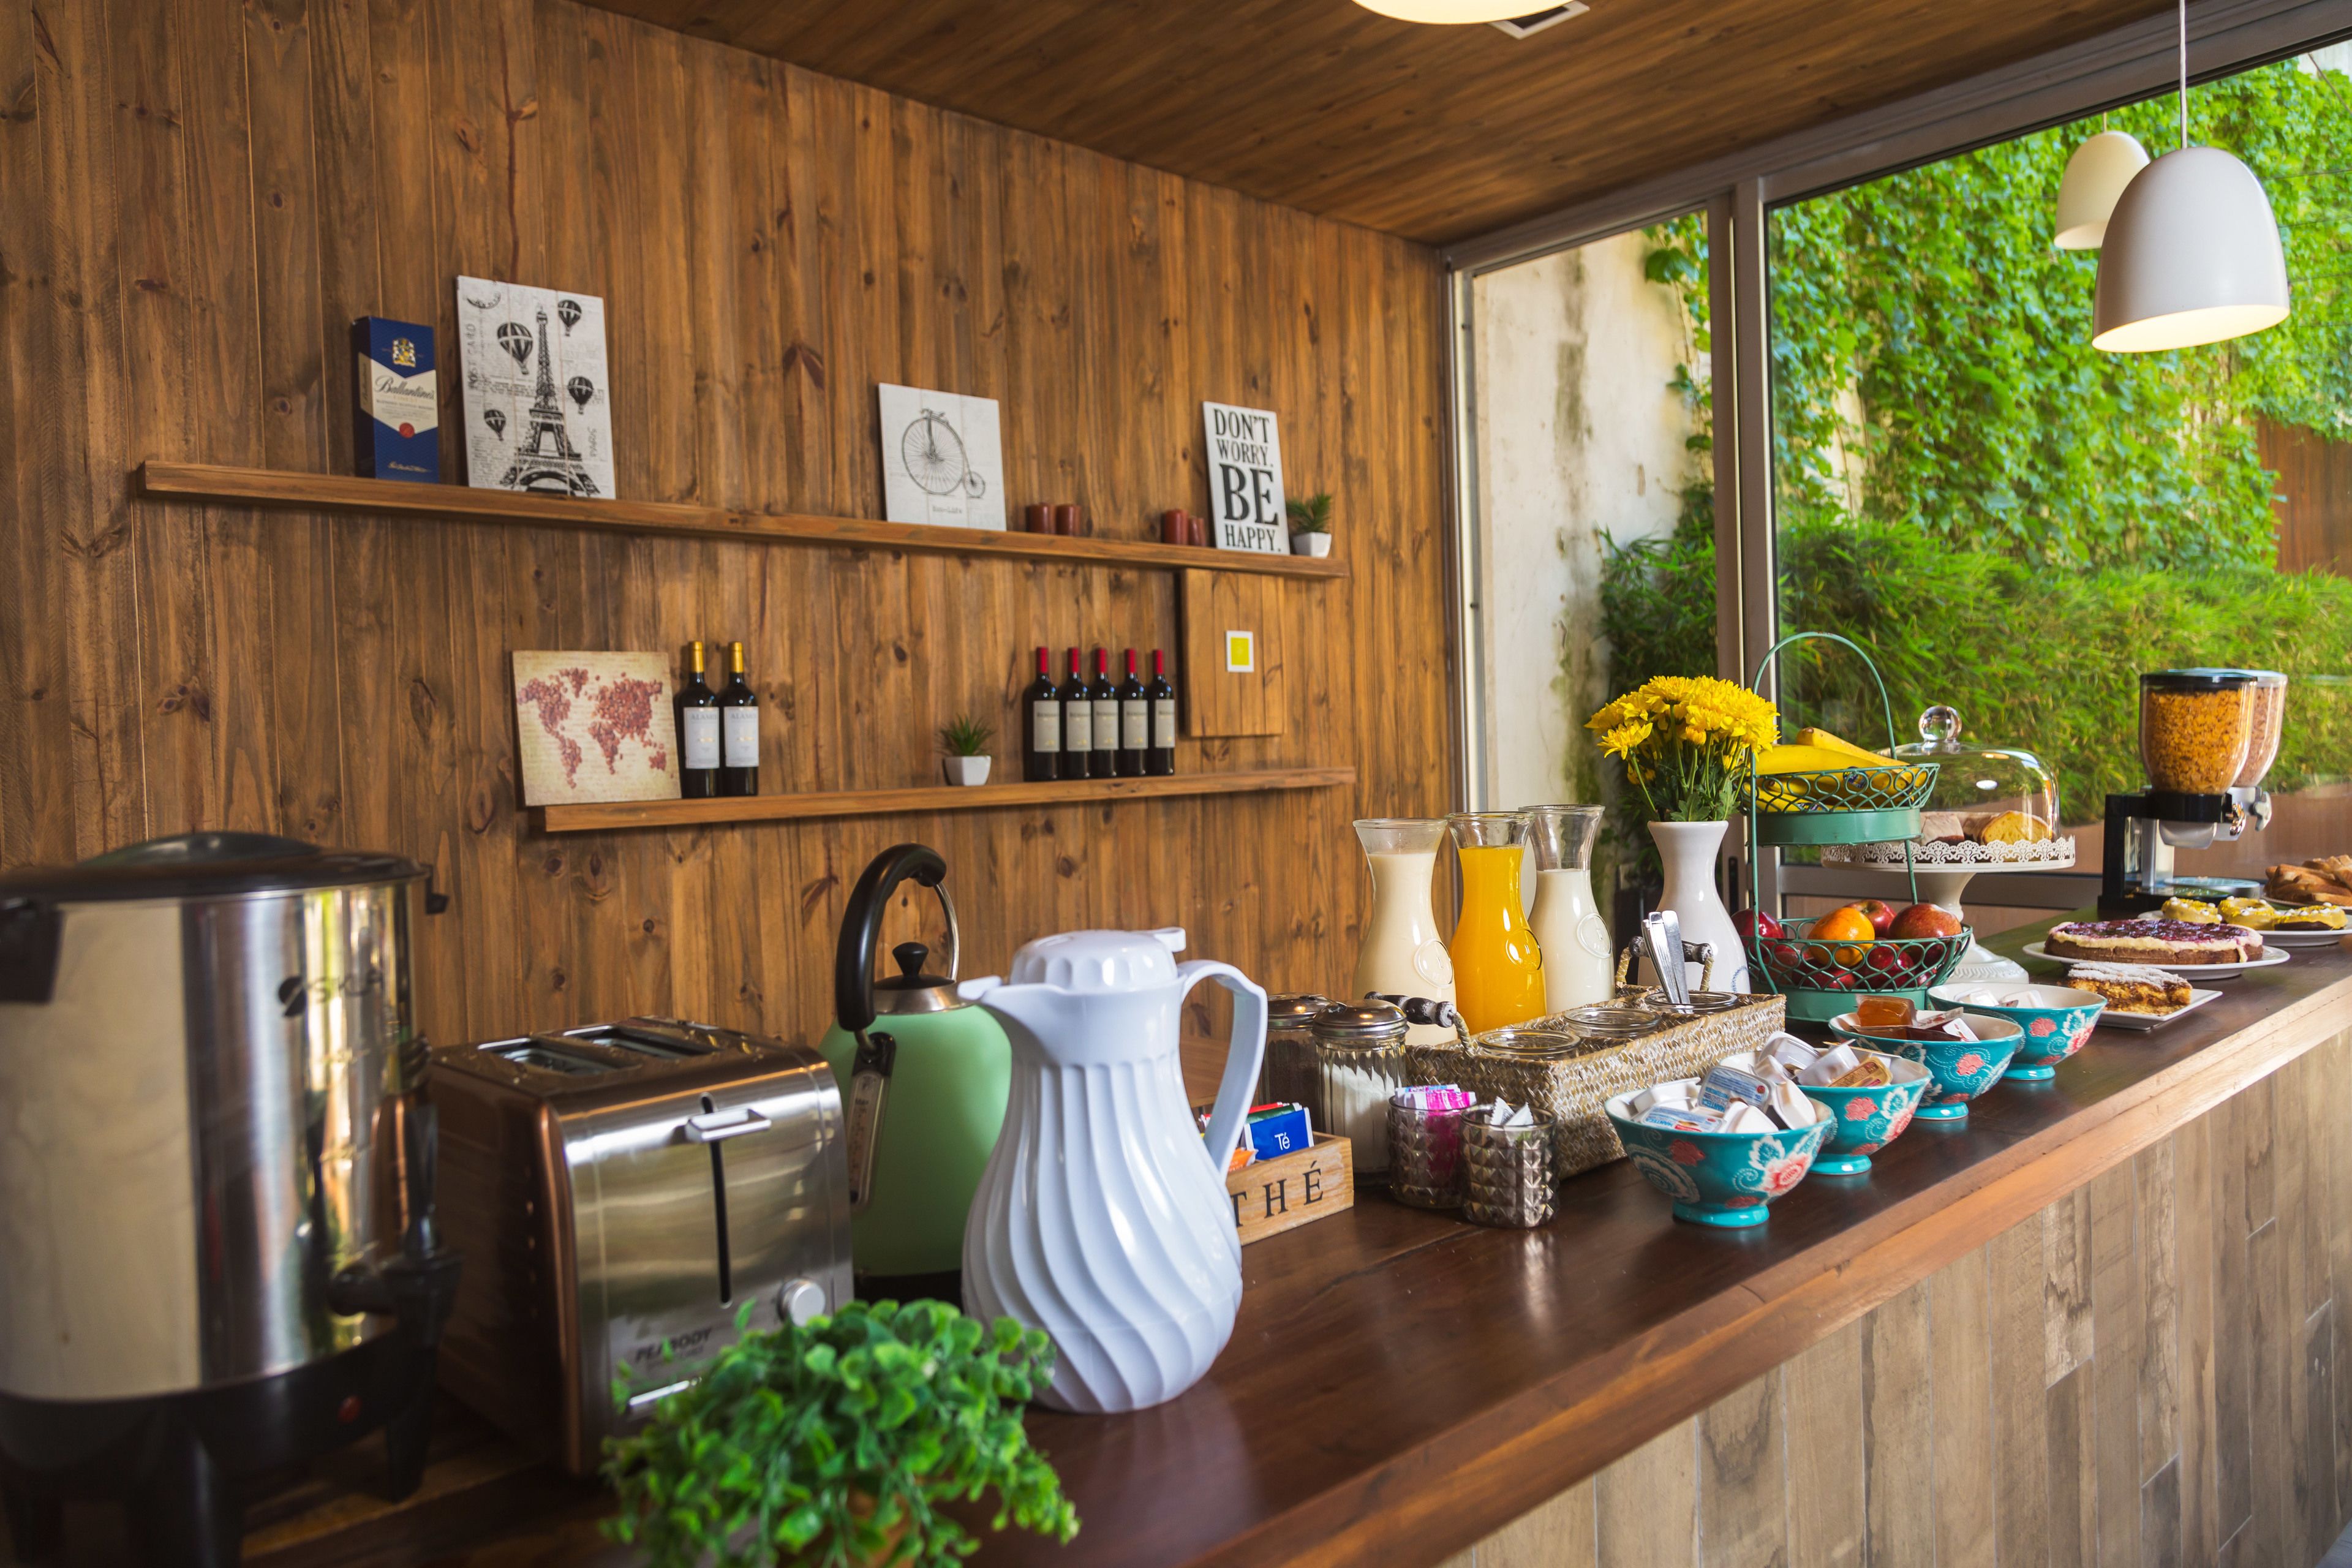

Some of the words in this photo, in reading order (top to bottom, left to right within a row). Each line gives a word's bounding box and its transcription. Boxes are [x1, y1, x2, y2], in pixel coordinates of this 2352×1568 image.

[374, 374, 435, 399] Ballantine's
[1214, 408, 1270, 443] DON'T
[1216, 438, 1273, 467] WORRY.
[1219, 462, 1279, 526] BE
[1225, 523, 1281, 551] HAPPY.
[1274, 1132, 1291, 1151] Té
[1231, 1160, 1324, 1228] THÉ
